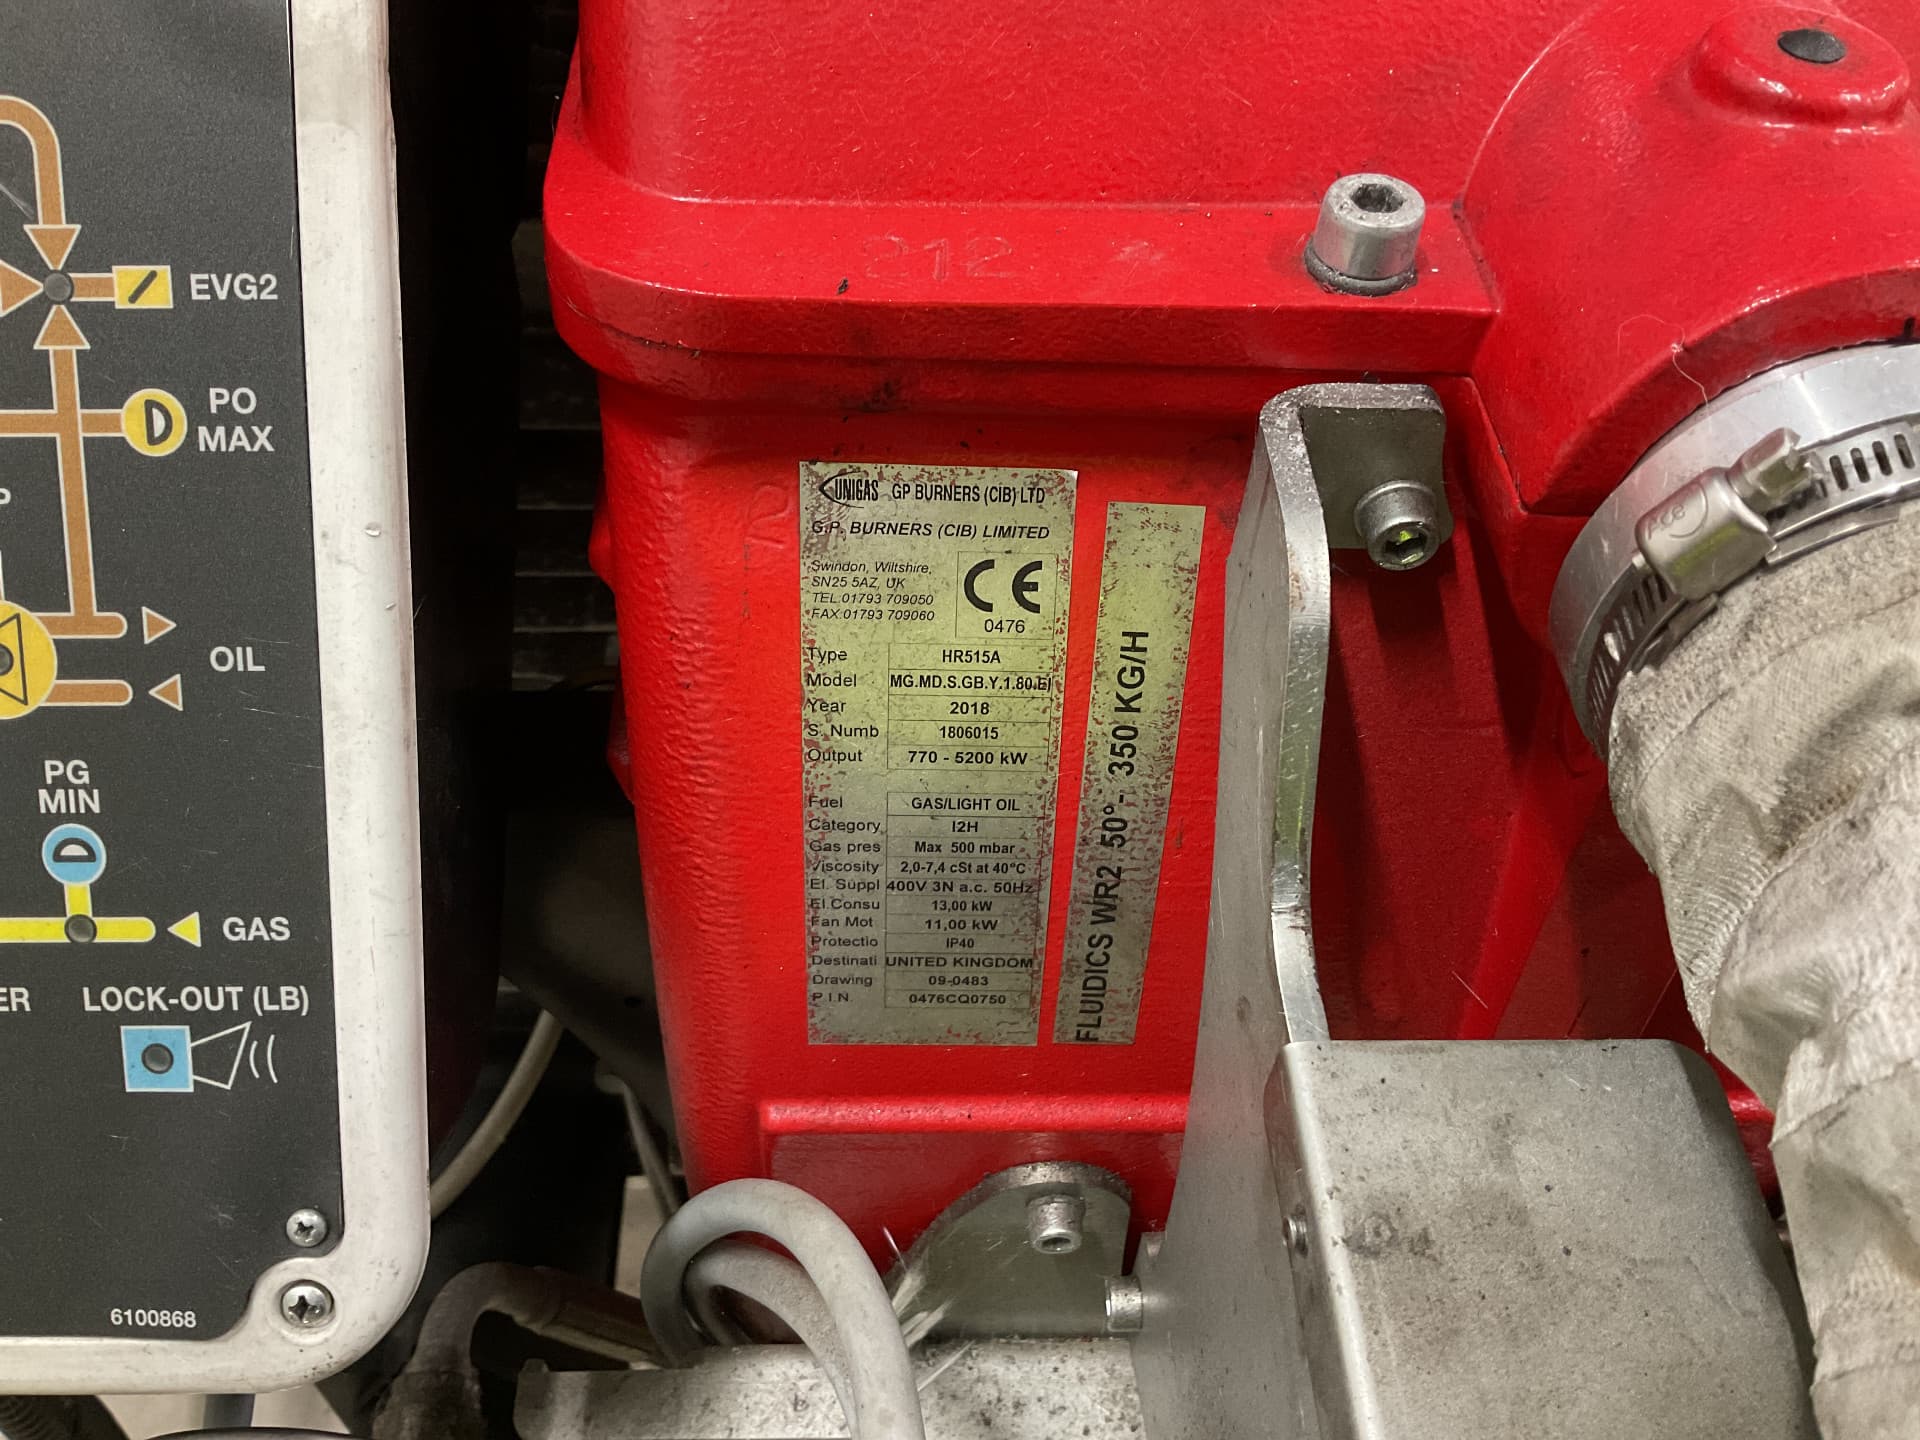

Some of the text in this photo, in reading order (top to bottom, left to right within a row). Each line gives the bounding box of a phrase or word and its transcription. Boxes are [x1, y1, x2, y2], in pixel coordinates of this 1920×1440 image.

[190, 273, 279, 300] EVG2
[208, 387, 257, 414] PO
[197, 426, 275, 452] MAX
[834, 479, 879, 501] UNIGAS
[892, 484, 1045, 506] GP BURNERS (CIB) LTD
[811, 521, 1050, 540] G.P. BURNERS (CIB) LIMITED
[811, 560, 869, 574] Swindon,
[811, 576, 905, 590] SN25 5AZ, UK
[886, 594, 934, 606] 709050
[887, 609, 935, 621] 709060
[984, 618, 1025, 634] 0476
[210, 646, 266, 673] OIL
[808, 648, 1001, 664] Type HR515A
[807, 673, 857, 687] Model
[1114, 631, 1149, 713] KG/H
[808, 701, 990, 715] Year 2018
[807, 724, 999, 740] S. Numb 1806015
[808, 748, 863, 763] Output
[908, 751, 938, 764] 770
[954, 751, 994, 765] 5200
[1000, 752, 1028, 765] kW
[1107, 725, 1139, 776] 350
[44, 759, 90, 785] PG
[38, 788, 101, 814] MIN
[808, 796, 1020, 811] Fuel GAS/LIGHT OIL
[808, 818, 979, 833] Category I2H
[809, 840, 1015, 855] Gas pres Max 500 mbar
[900, 861, 946, 875] 2,0-7,4
[950, 861, 973, 874] cSt
[976, 862, 989, 874] at
[992, 861, 1026, 875] 40°C
[835, 878, 880, 893] Suppl
[886, 880, 928, 892] 400V
[932, 881, 954, 893] 3N
[959, 884, 988, 894] a.c.
[993, 881, 1034, 894] 50Hz
[1090, 865, 1122, 926] WR2
[931, 899, 967, 912] 13,00
[971, 899, 993, 912] kW
[222, 917, 290, 941] GAS
[811, 915, 998, 932] Fan Mot 11,00 kW
[811, 934, 975, 949] Protectio IP40
[811, 954, 1034, 969] Destinati UNITED KINGDOM
[812, 974, 989, 988] Drawing 09-0483
[1075, 933, 1114, 1042] FLUIDICS
[82, 985, 309, 1016] LOCK-OUT (LB)
[909, 993, 1007, 1005] 0476CQ0750
[110, 1308, 197, 1328] 6100868
